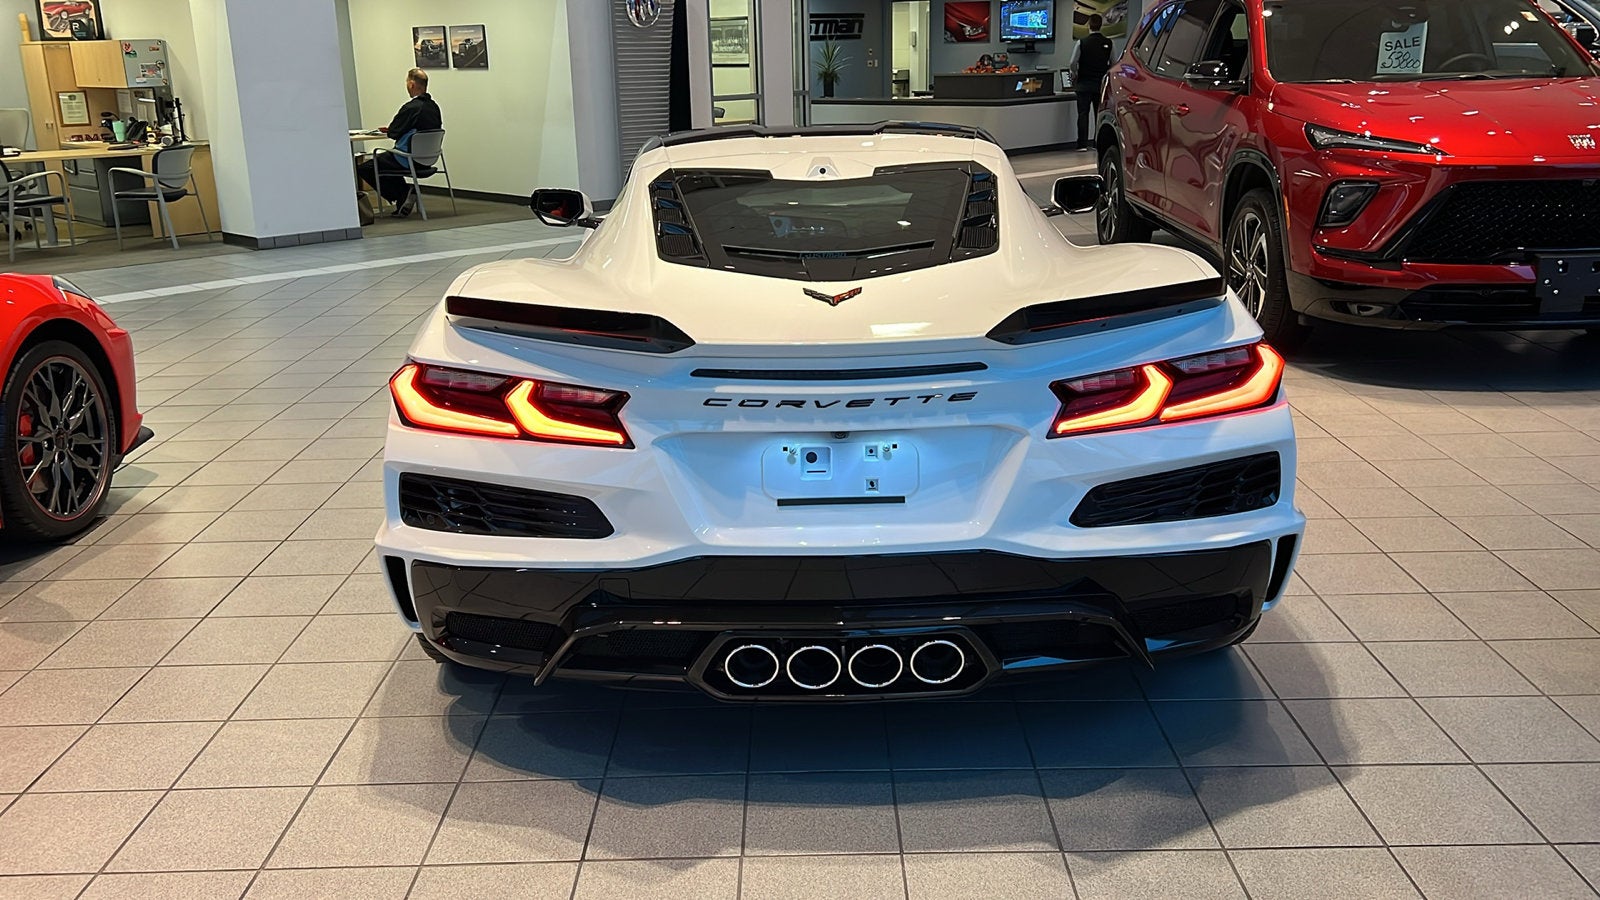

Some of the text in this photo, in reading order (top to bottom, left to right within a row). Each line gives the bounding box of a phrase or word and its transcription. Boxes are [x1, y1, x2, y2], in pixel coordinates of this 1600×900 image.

[809, 17, 864, 36] tman
[1384, 36, 1421, 51] SALE
[702, 391, 978, 409] CORVETTE
